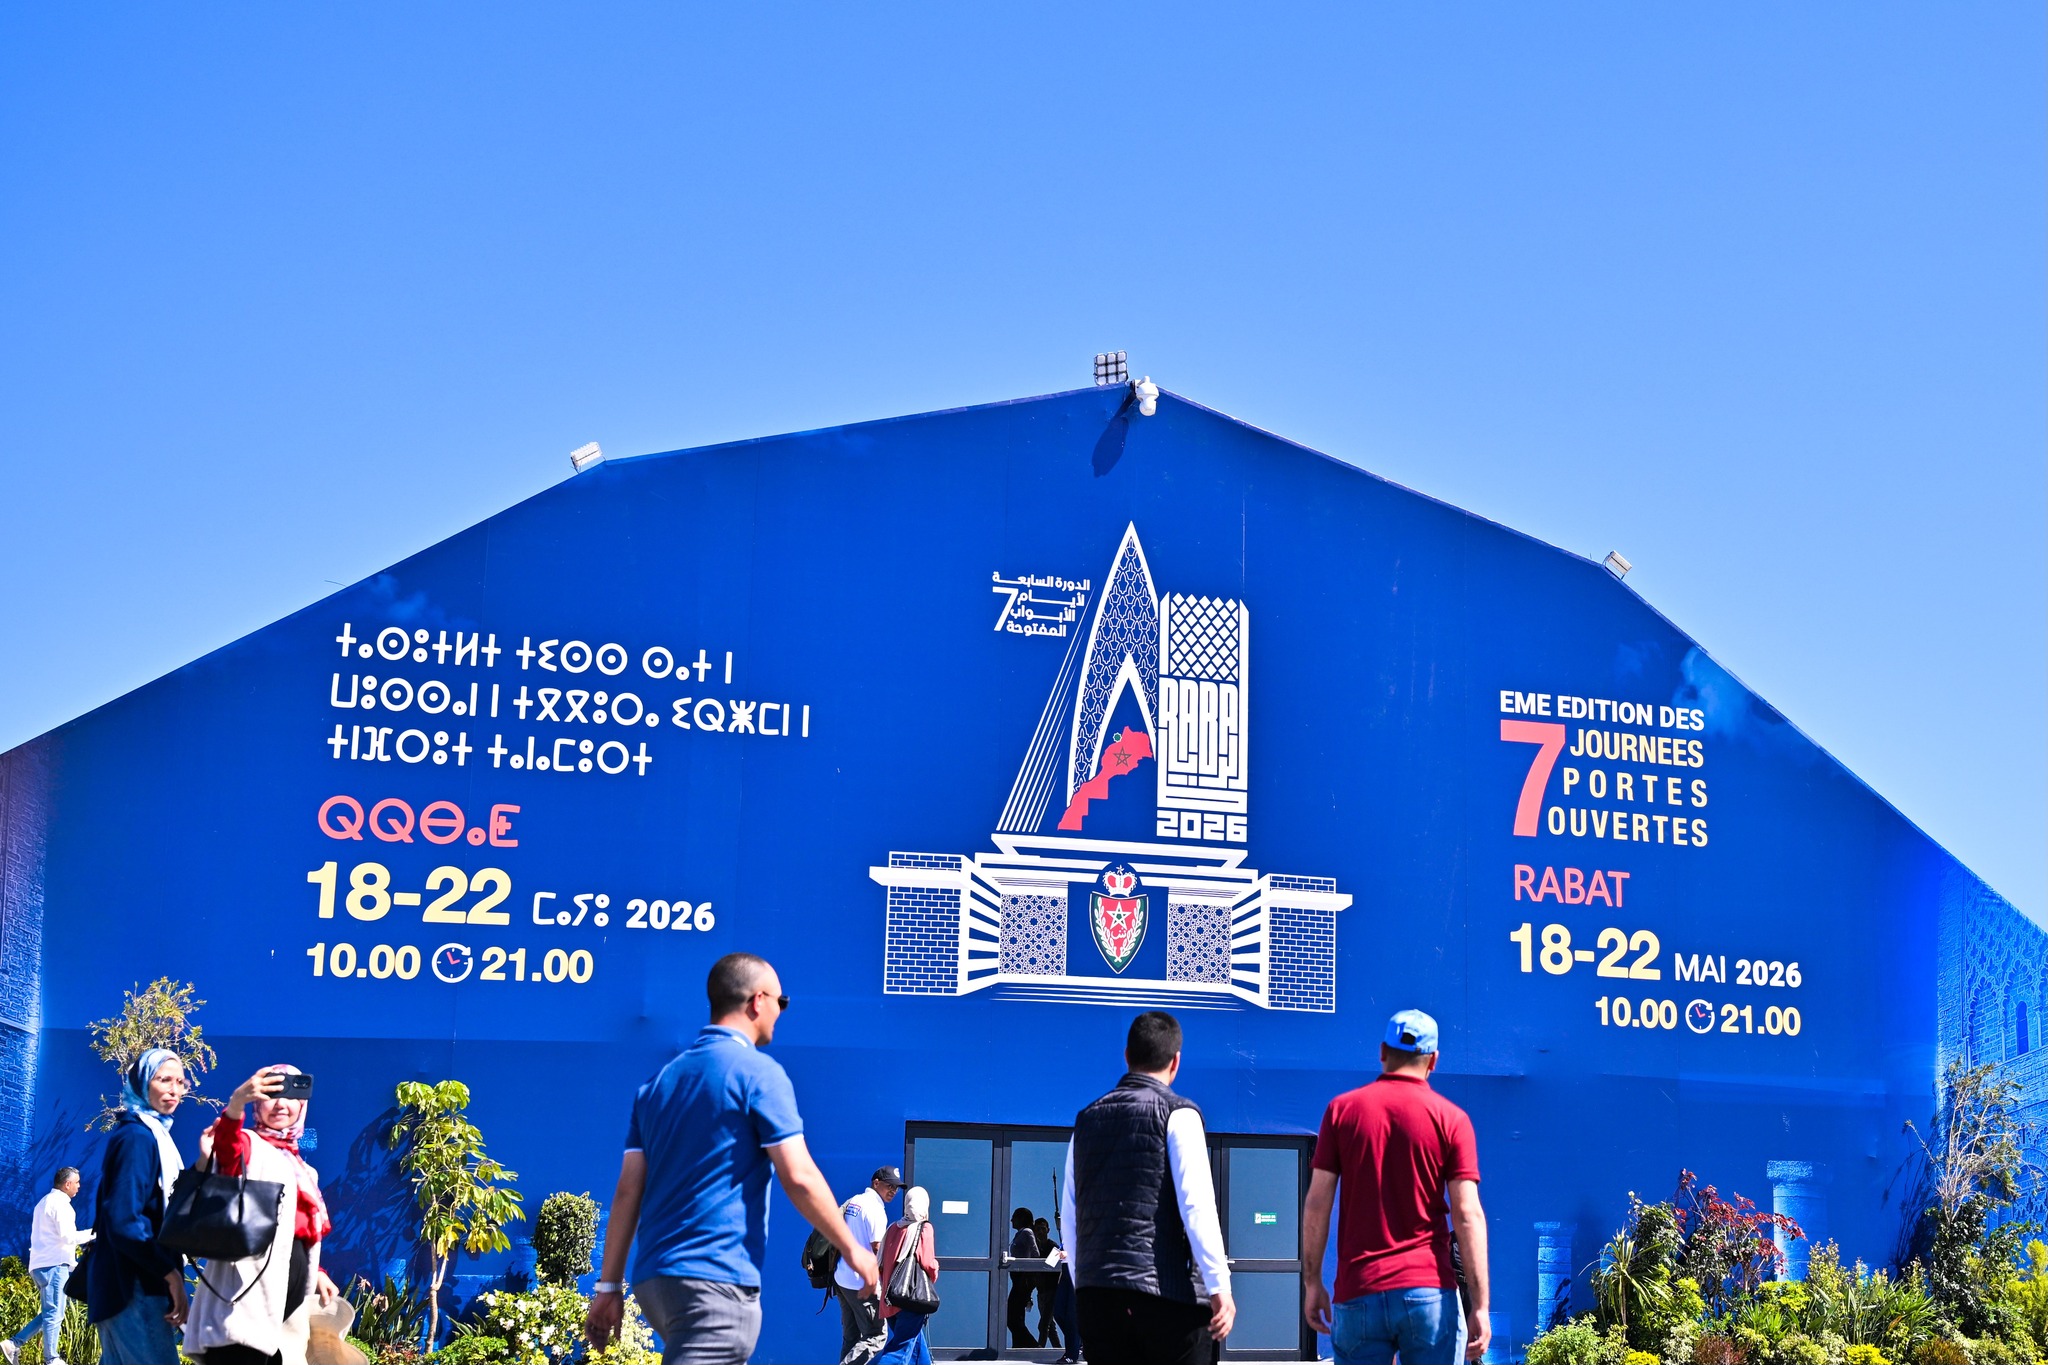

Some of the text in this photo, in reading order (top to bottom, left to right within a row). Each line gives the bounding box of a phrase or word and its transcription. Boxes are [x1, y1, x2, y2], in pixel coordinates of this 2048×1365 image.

[1055, 576, 1091, 592] الدورة
[992, 586, 1019, 632] 7
[1006, 620, 1067, 638] المفتوحة
[1010, 605, 1076, 623] الأبواب
[1499, 690, 1705, 731] EME EDITION DES
[1569, 728, 1704, 769] JOURNEES
[1500, 719, 1567, 838] 7
[1563, 767, 1708, 808] PORTES
[1157, 809, 1248, 843] 2026
[1547, 805, 1709, 848] OUVERTES
[306, 861, 512, 927] 18-22
[625, 898, 717, 932] 2026
[1514, 864, 1631, 908] RABAT
[306, 942, 594, 984] 10.00 21.00
[1509, 922, 1803, 988] 18-22 MAI 2026
[1595, 995, 1802, 1037] 10.00 21.00
